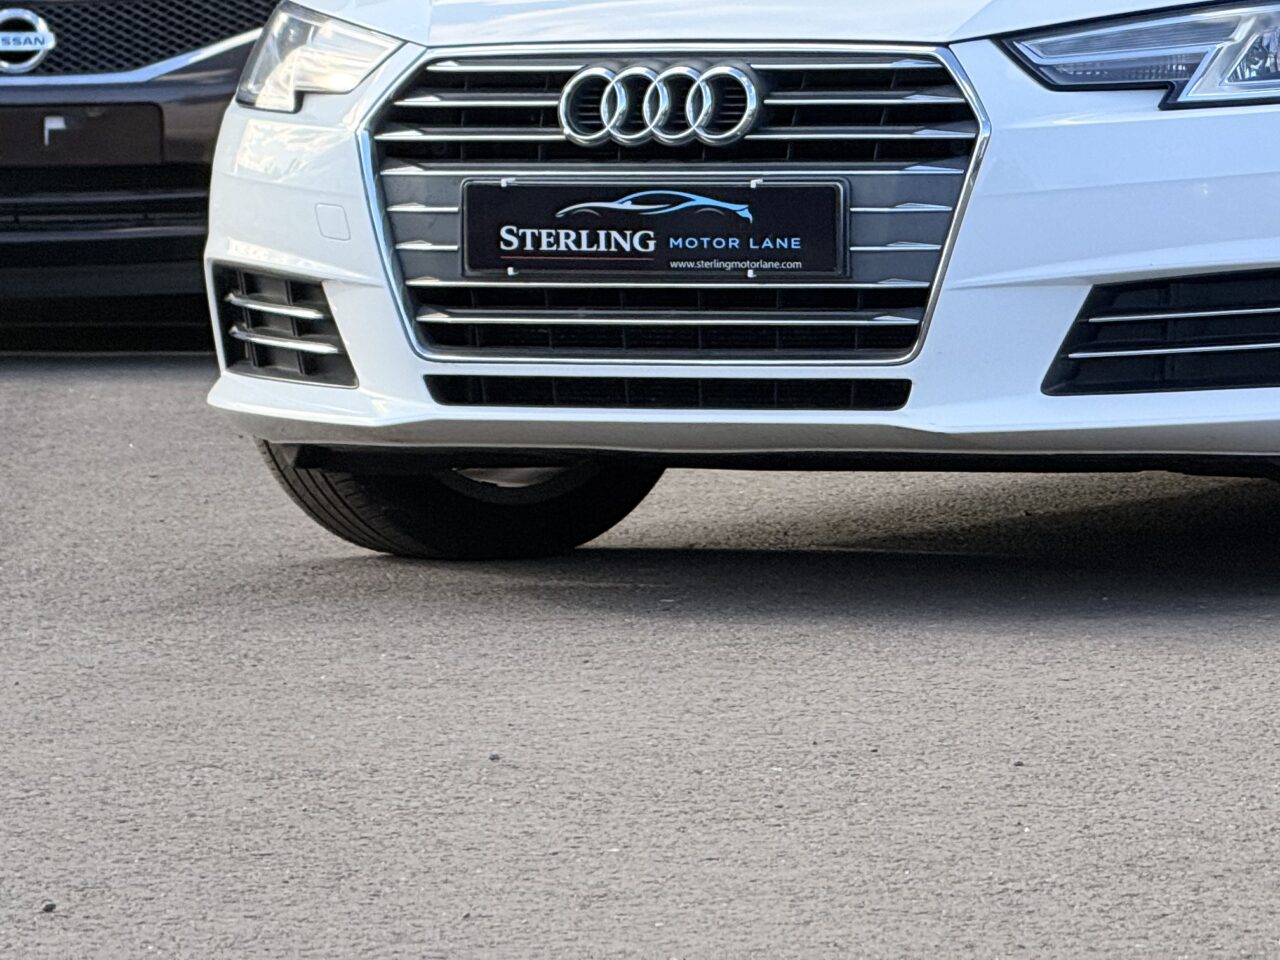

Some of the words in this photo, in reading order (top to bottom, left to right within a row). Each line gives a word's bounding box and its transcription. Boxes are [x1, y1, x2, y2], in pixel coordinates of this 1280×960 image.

[499, 225, 656, 253] STERLING
[670, 237, 740, 250] MOTOR
[750, 237, 801, 250] LANE
[670, 259, 802, 271] www.sterlingmotorlane.com
